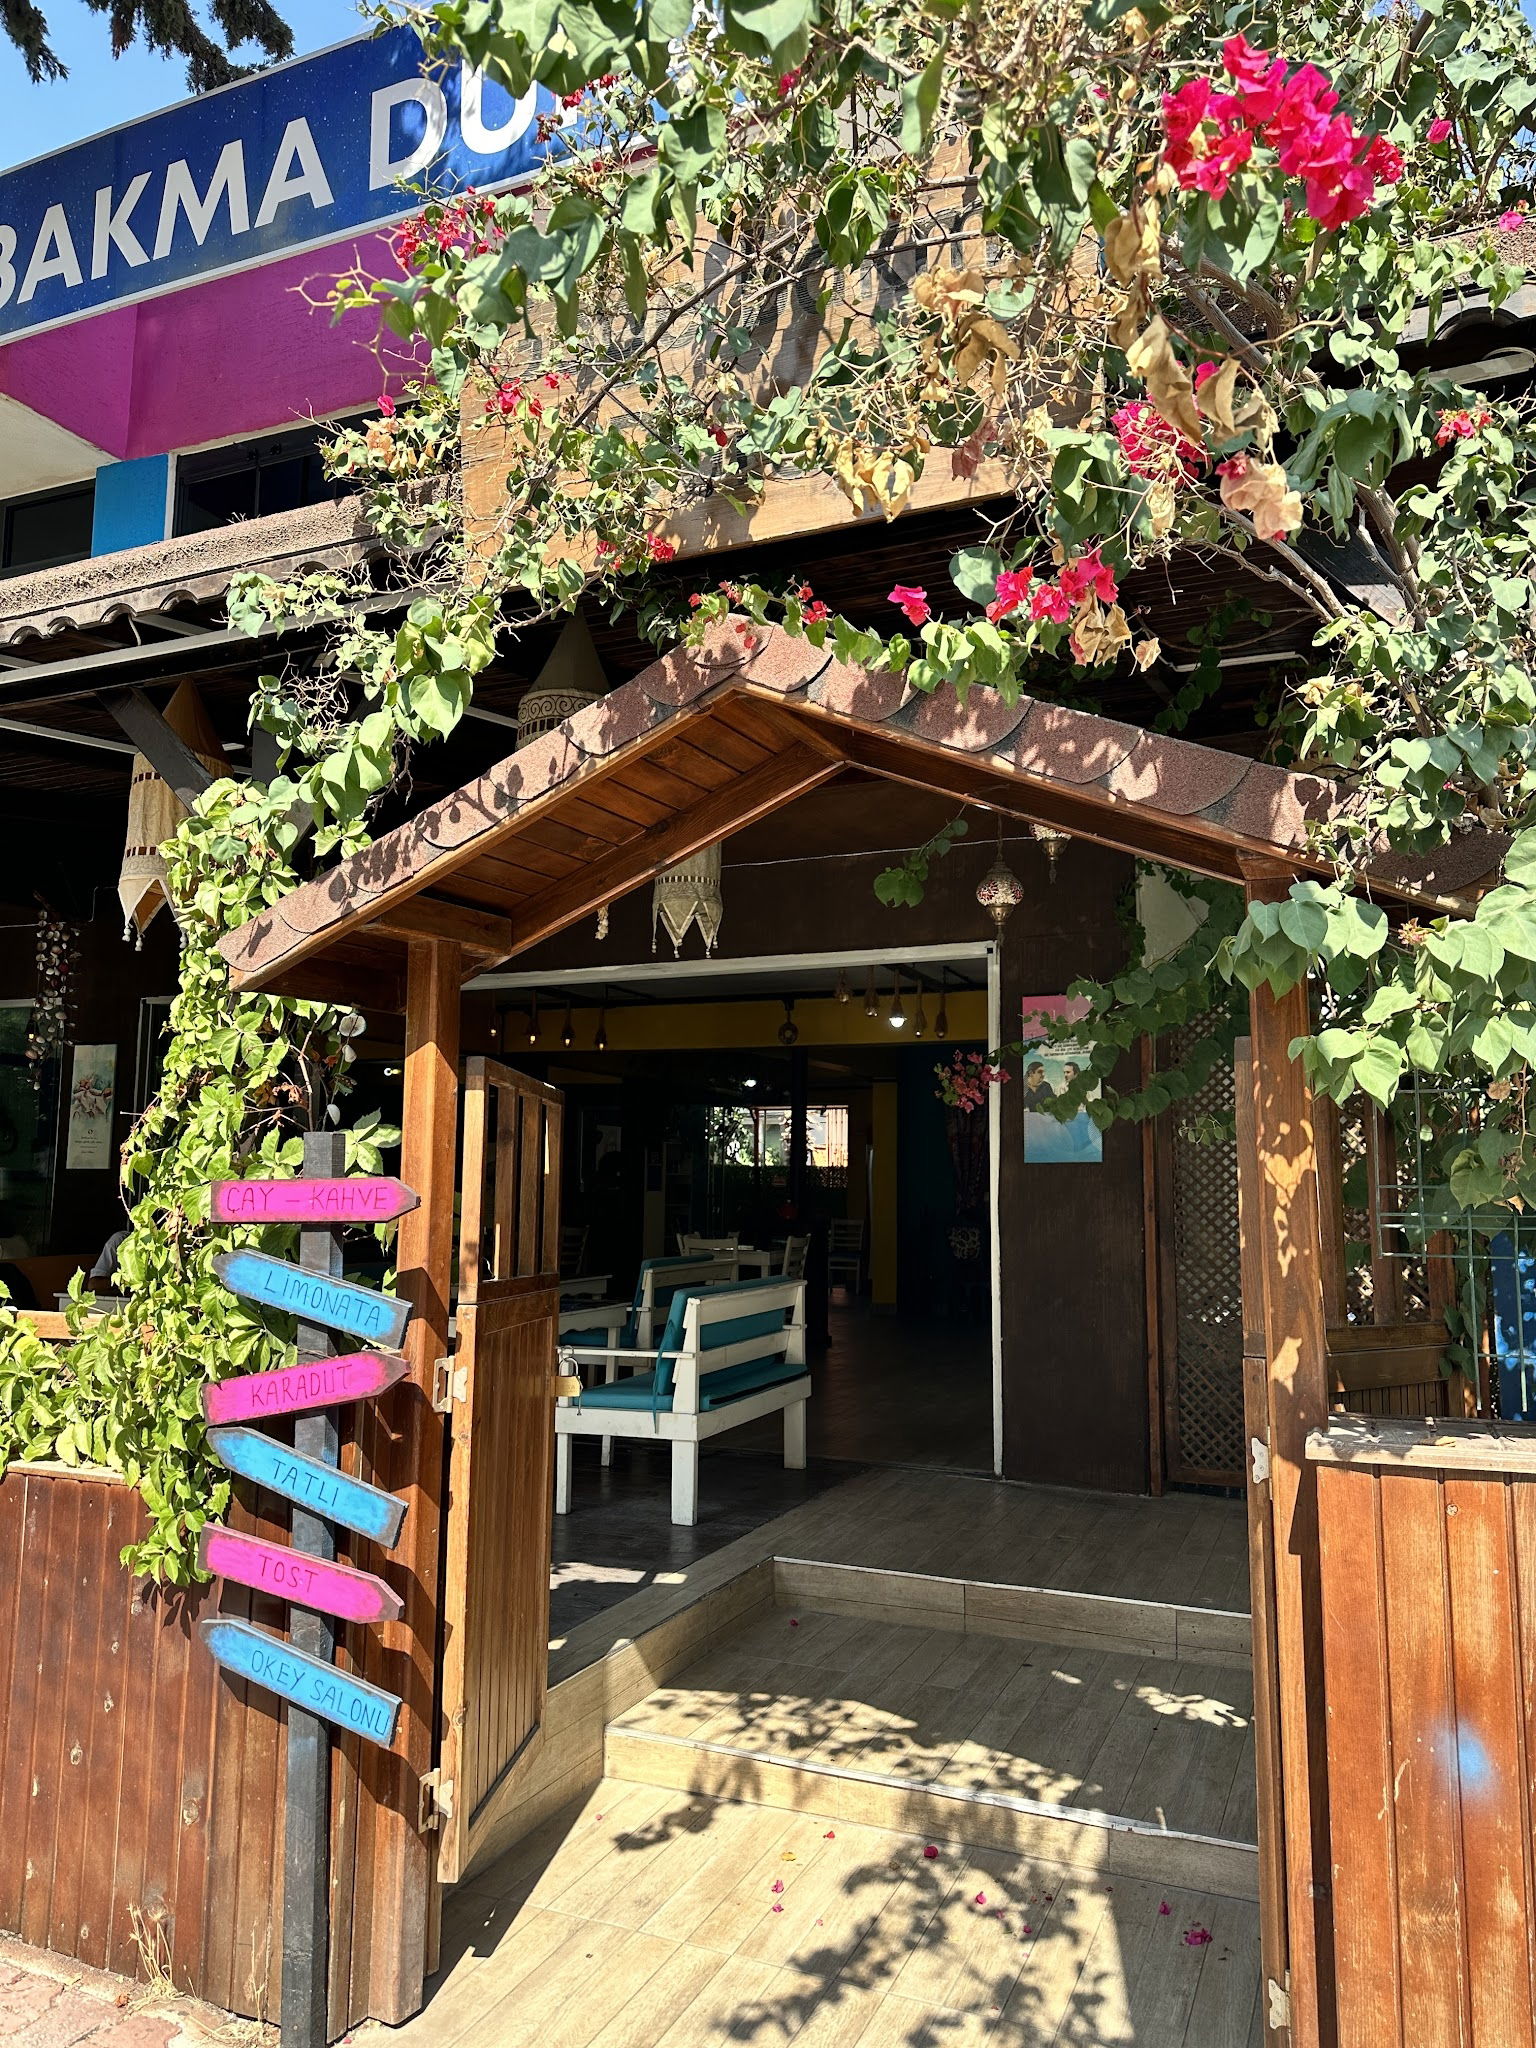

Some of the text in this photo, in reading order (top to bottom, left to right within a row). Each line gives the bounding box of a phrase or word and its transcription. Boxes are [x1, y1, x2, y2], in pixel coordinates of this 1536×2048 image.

[226, 1187, 274, 1213] ÇAY
[309, 1186, 389, 1210] KAHVE
[251, 1364, 353, 1407] KARADUT
[272, 1458, 339, 1508] TATLI
[258, 1554, 319, 1593] TOST
[251, 1650, 391, 1736] OKEY SALONU
